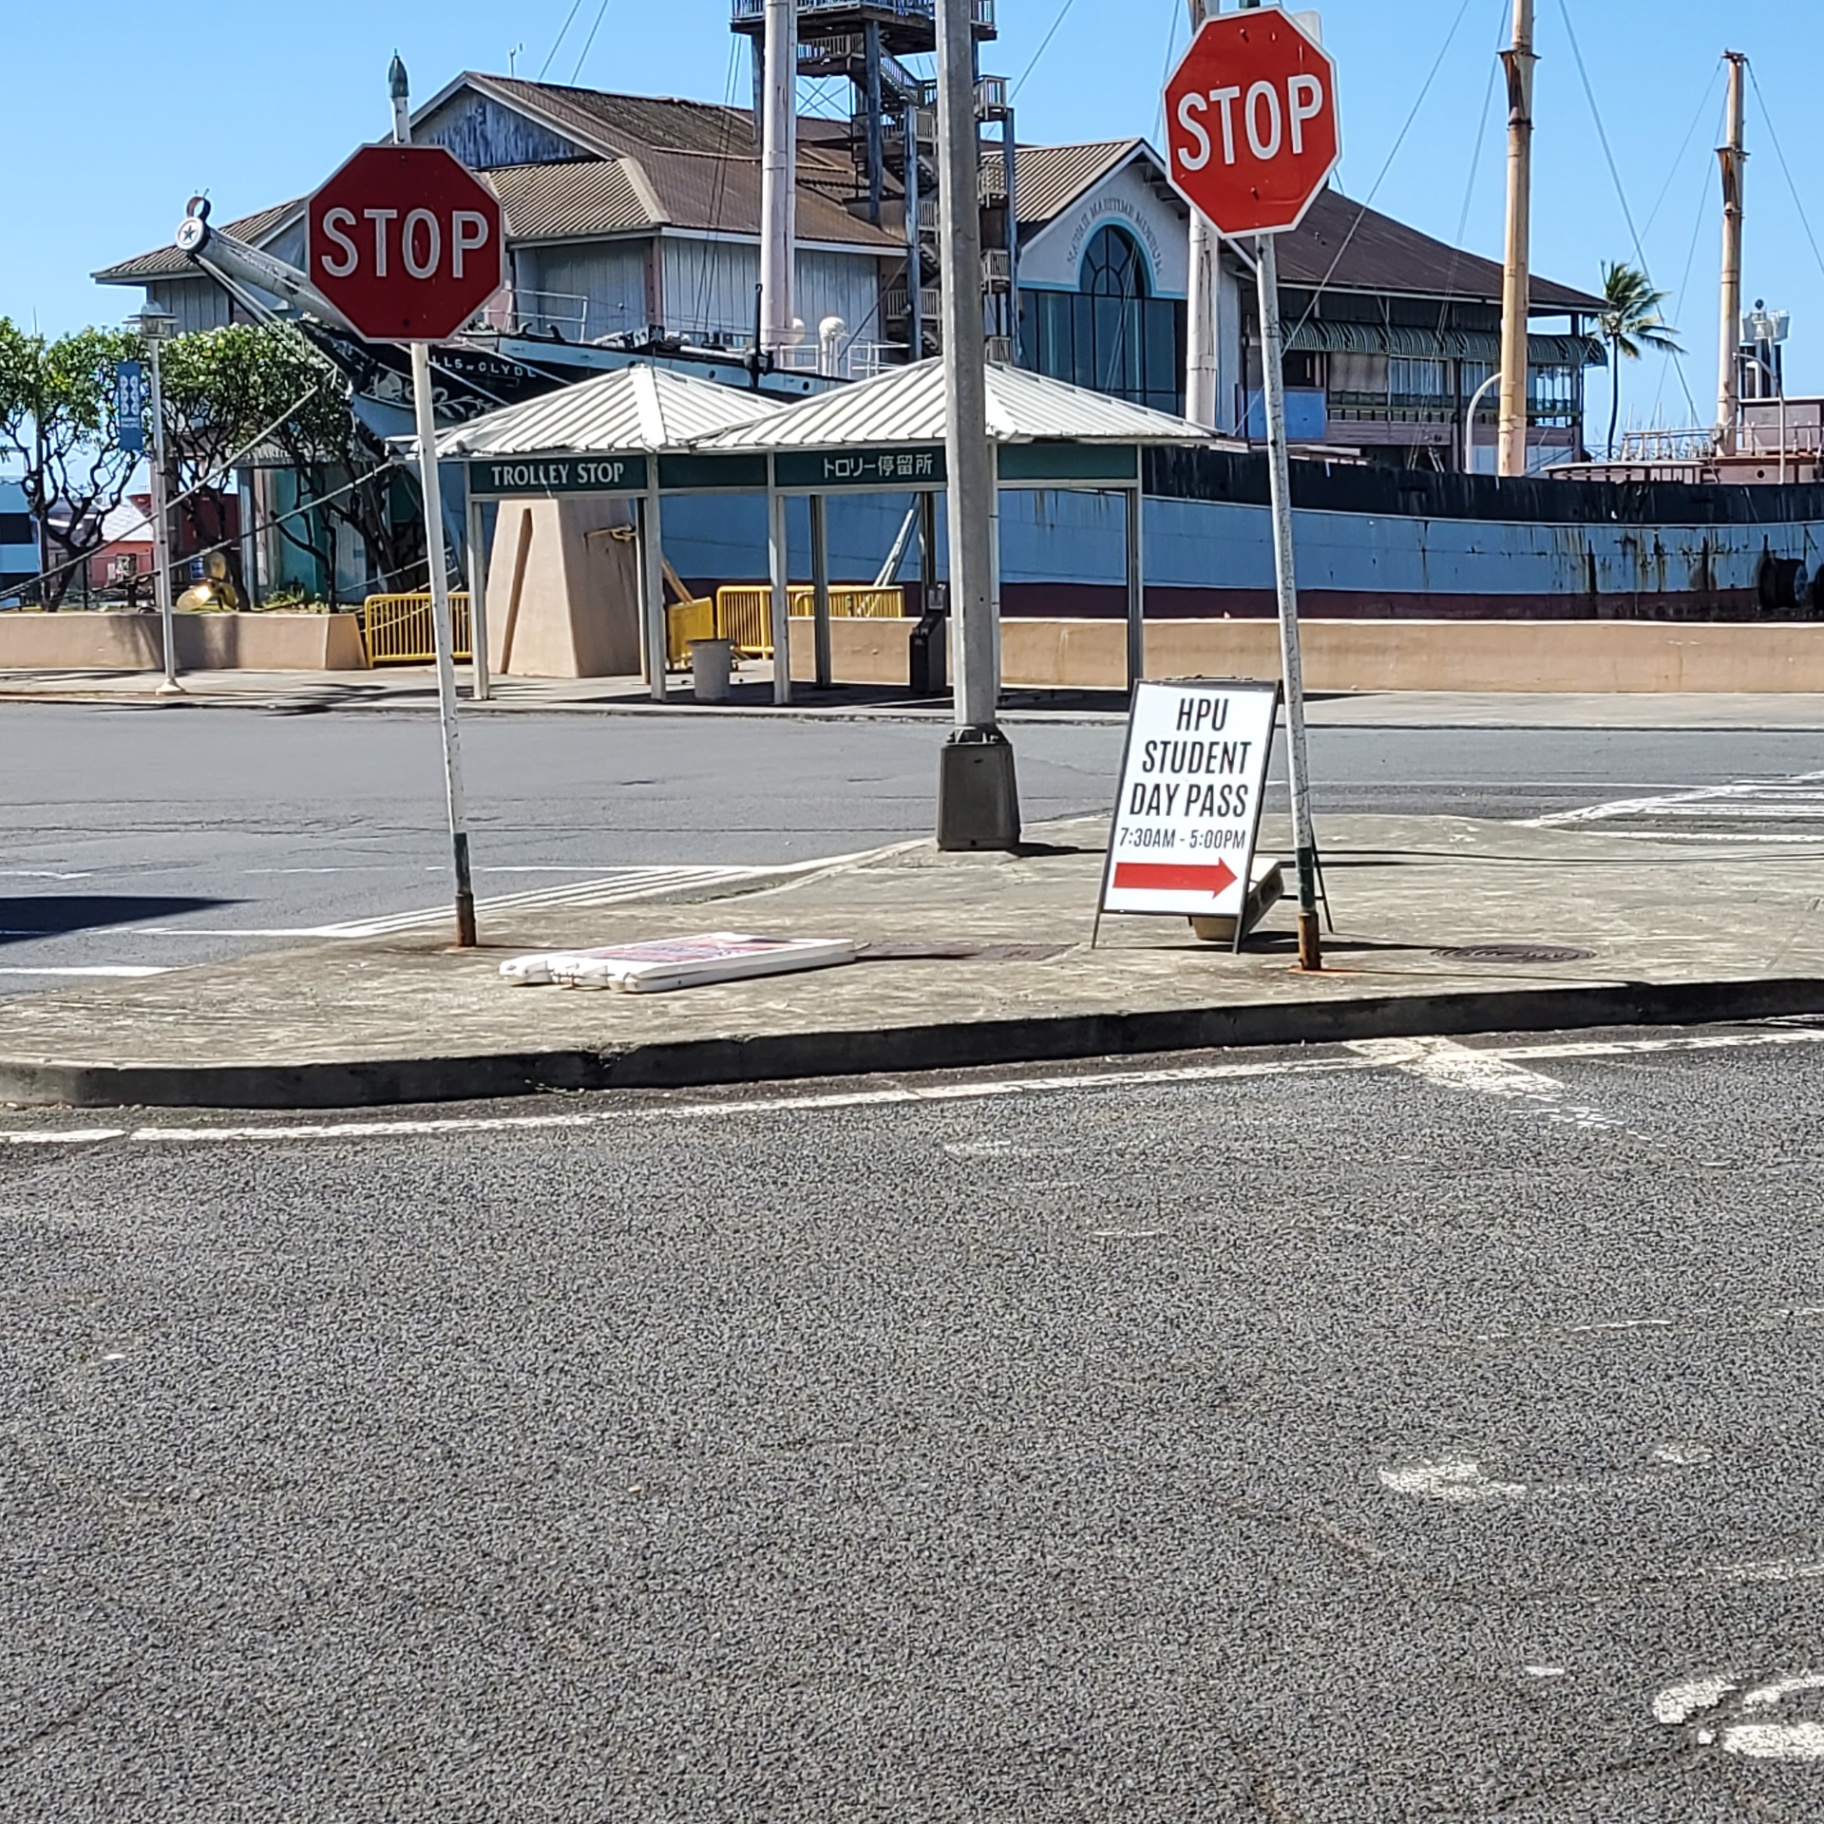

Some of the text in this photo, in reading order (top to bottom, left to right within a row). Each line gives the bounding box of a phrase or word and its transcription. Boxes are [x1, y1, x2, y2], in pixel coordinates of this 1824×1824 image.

[1177, 74, 1323, 171] STOP
[321, 207, 489, 279] STOP
[491, 462, 625, 486] TROLLEY STOP
[824, 453, 933, 479] トロリー停留所
[1176, 698, 1229, 731] HPU
[1142, 740, 1252, 774] STUDENT
[1129, 782, 1249, 817] DAY PASS
[1119, 827, 1176, 848] 7:30AM
[1189, 829, 1246, 849] 5:00PM
